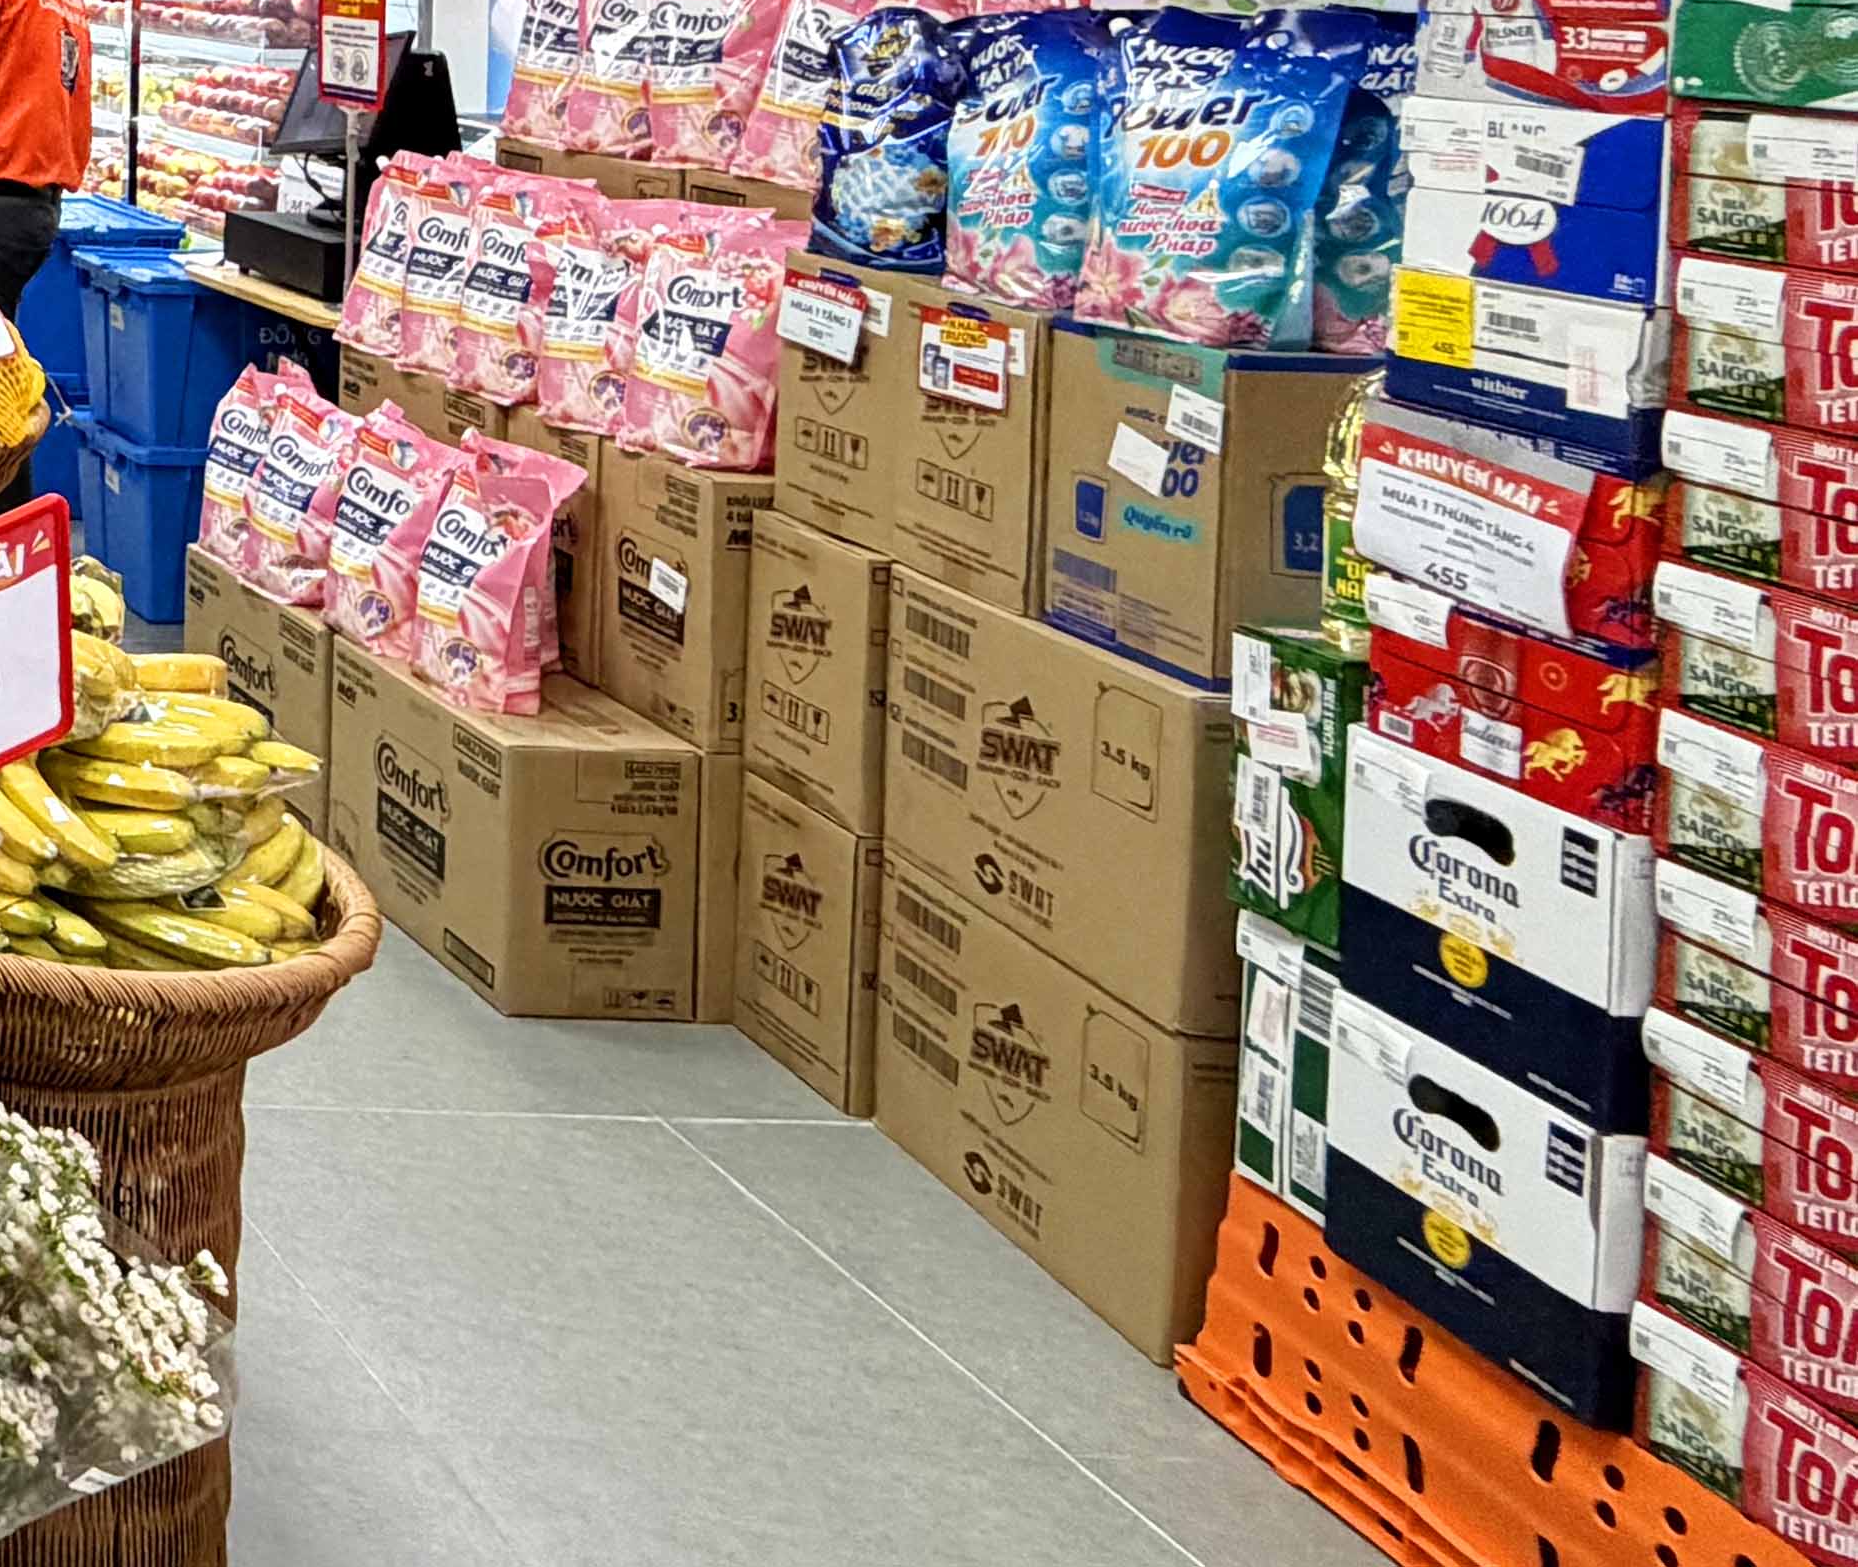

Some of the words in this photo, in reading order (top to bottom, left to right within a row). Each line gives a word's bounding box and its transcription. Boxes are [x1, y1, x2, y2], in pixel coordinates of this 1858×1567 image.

[1480, 199, 1547, 227] 1664
[1424, 561, 1469, 593] 455
[978, 731, 1061, 777] SWAT
[1099, 737, 1130, 764] 3.5
[1131, 759, 1151, 783] kg
[544, 839, 662, 882] Comfort
[1409, 834, 1521, 909] Corona
[1393, 1108, 1505, 1197] Corona
